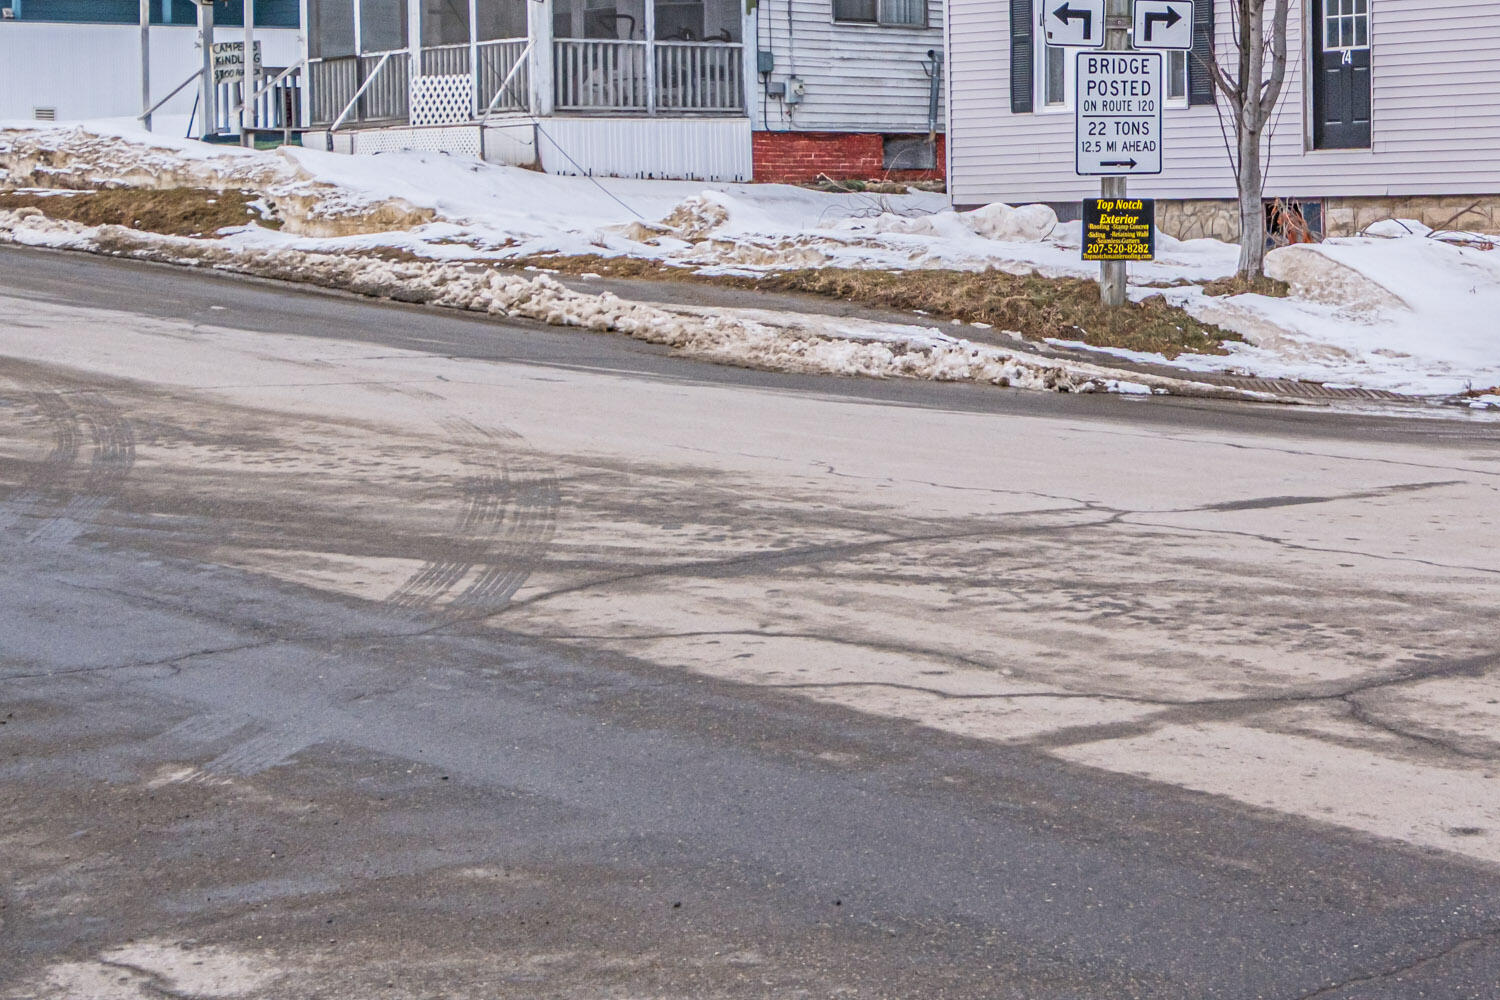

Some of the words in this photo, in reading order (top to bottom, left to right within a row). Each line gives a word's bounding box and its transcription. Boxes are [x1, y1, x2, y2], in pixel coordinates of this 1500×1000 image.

[213, 41, 258, 54] CAMPES
[1341, 49, 1351, 65] 74
[1088, 58, 1150, 75] BRIDGE
[1087, 80, 1151, 97] POSTED
[1083, 100, 1098, 112] ON
[1102, 100, 1132, 112] ROUTE
[1138, 100, 1154, 112] 120
[1088, 121, 1107, 136] 22
[1114, 121, 1150, 136] TONS
[1081, 141, 1102, 153] 12.5
[1106, 141, 1117, 152] MI
[1121, 140, 1156, 152] AHEAD
[1096, 200, 1114, 212] Top
[1115, 199, 1143, 210] Notch
[1100, 214, 1139, 223] Exterior
[1087, 244, 1149, 253] 207-520-8282
